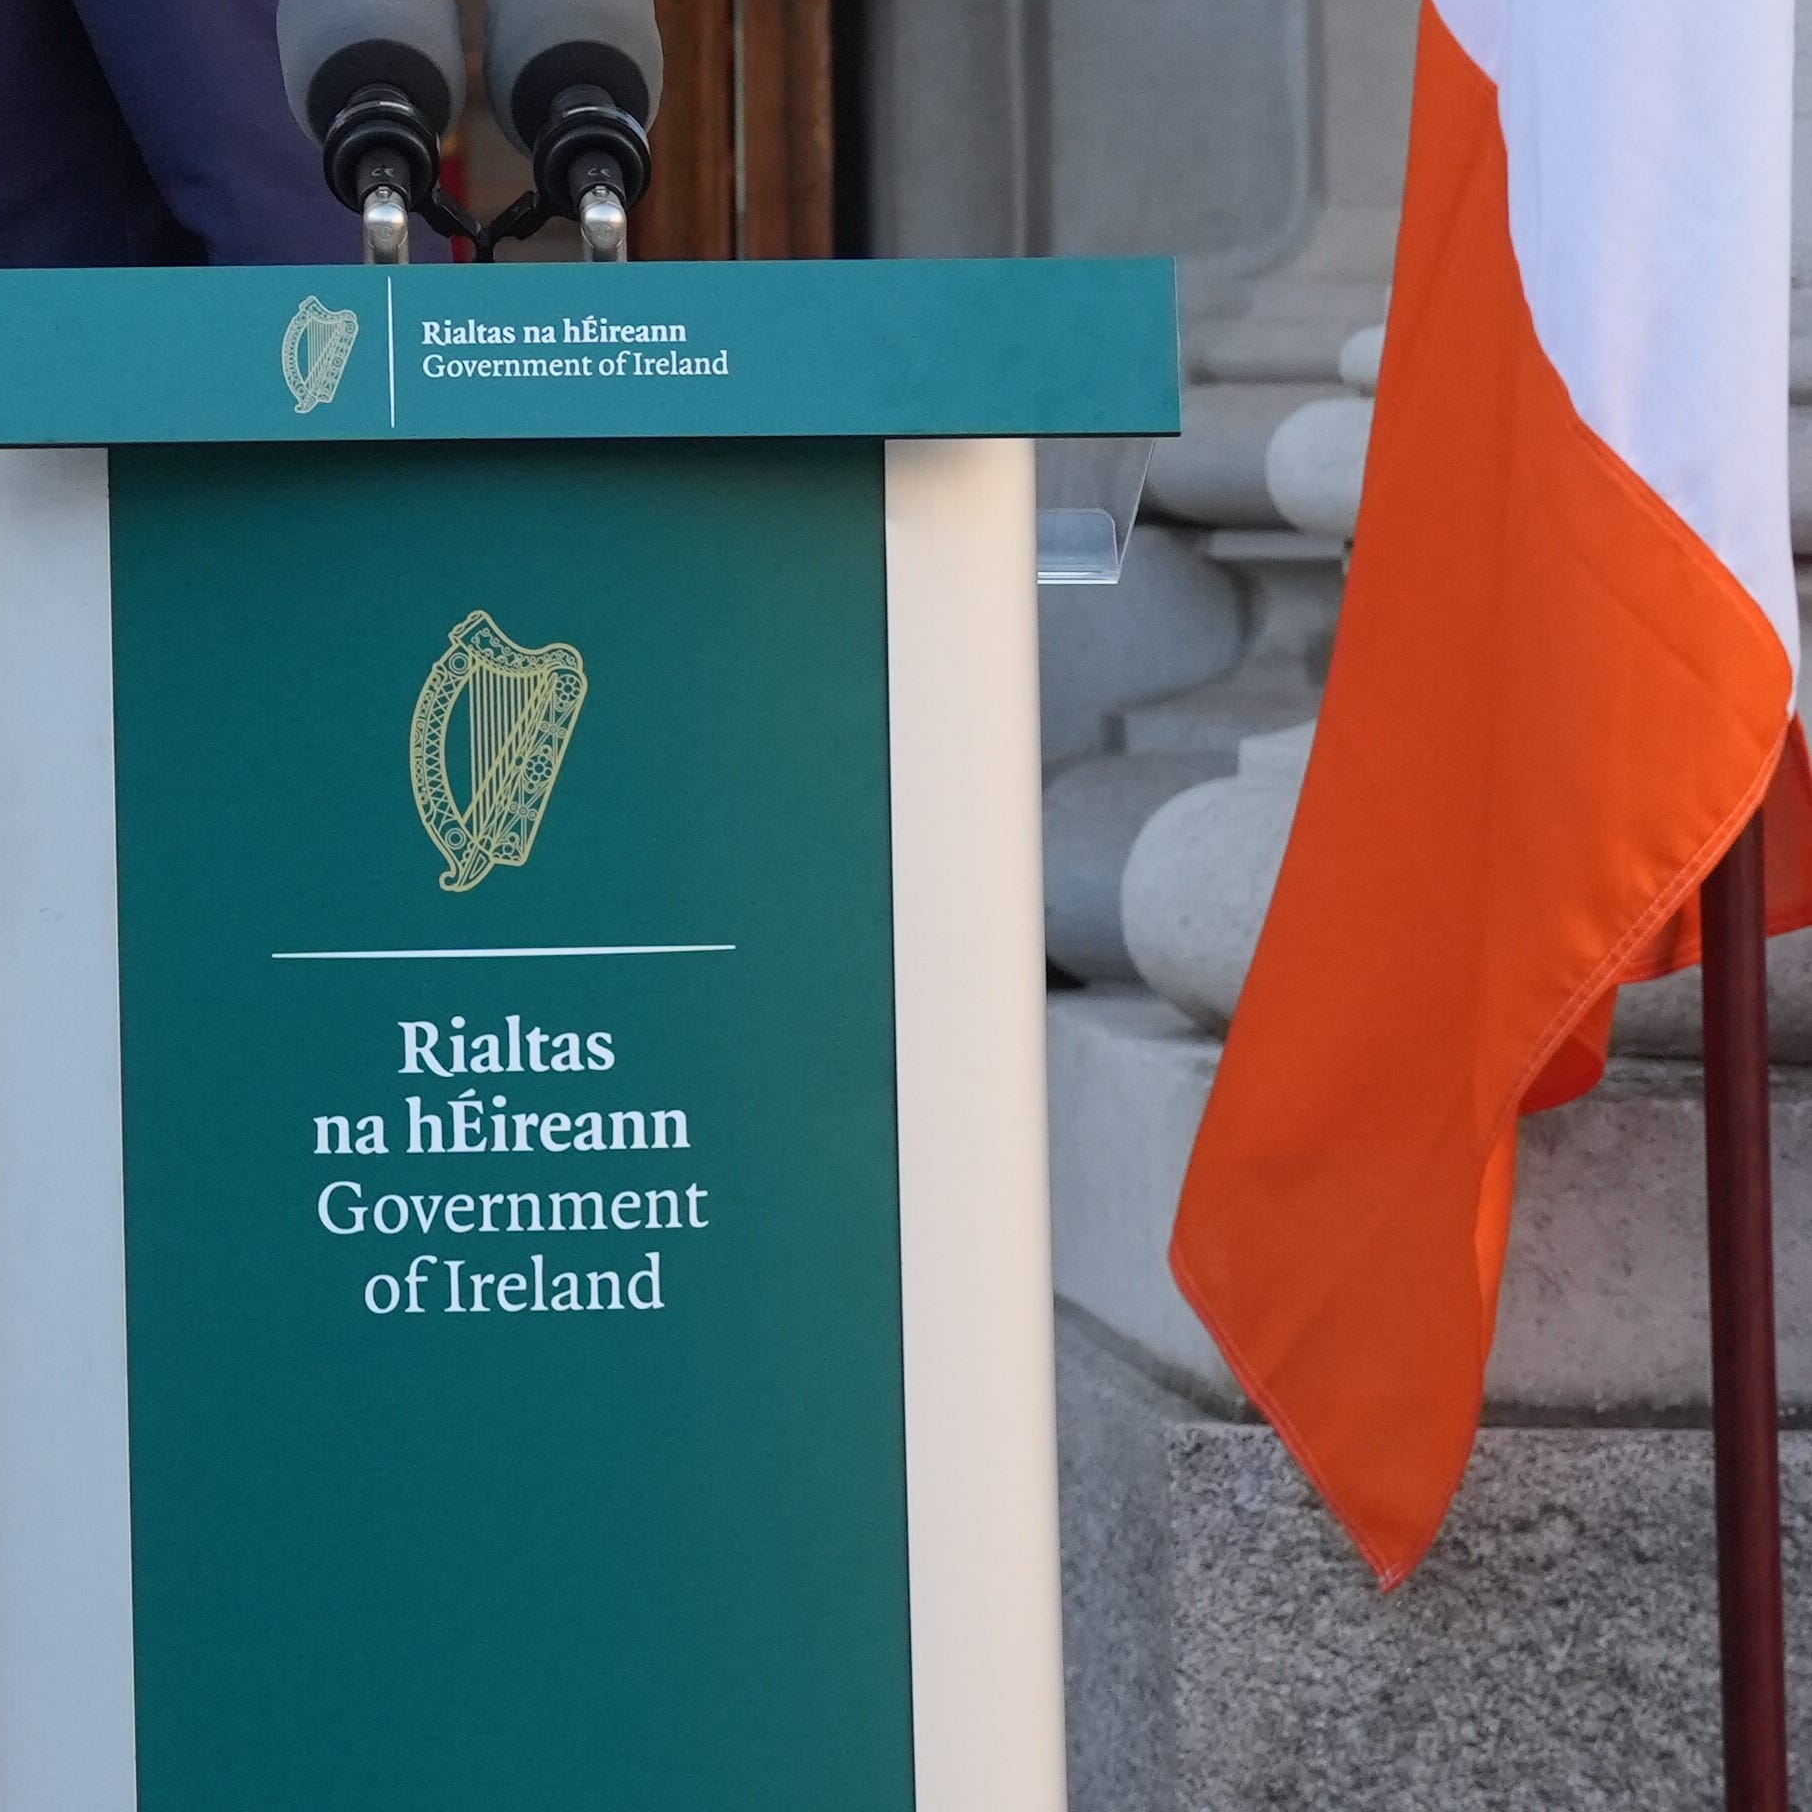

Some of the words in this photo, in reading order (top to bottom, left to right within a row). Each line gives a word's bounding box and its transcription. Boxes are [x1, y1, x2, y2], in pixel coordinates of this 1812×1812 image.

[421, 318, 516, 347] Rialtas
[522, 325, 557, 344] na
[562, 314, 687, 343] hÉireann
[422, 354, 593, 378] Government
[598, 350, 632, 376] of
[632, 349, 729, 376] Ireland
[397, 1014, 616, 1078] Rialtas
[312, 1115, 390, 1155] na
[405, 1088, 692, 1154] hÉireann
[317, 1180, 710, 1235] Government
[364, 1254, 438, 1314] of
[442, 1251, 666, 1313] Ireland
